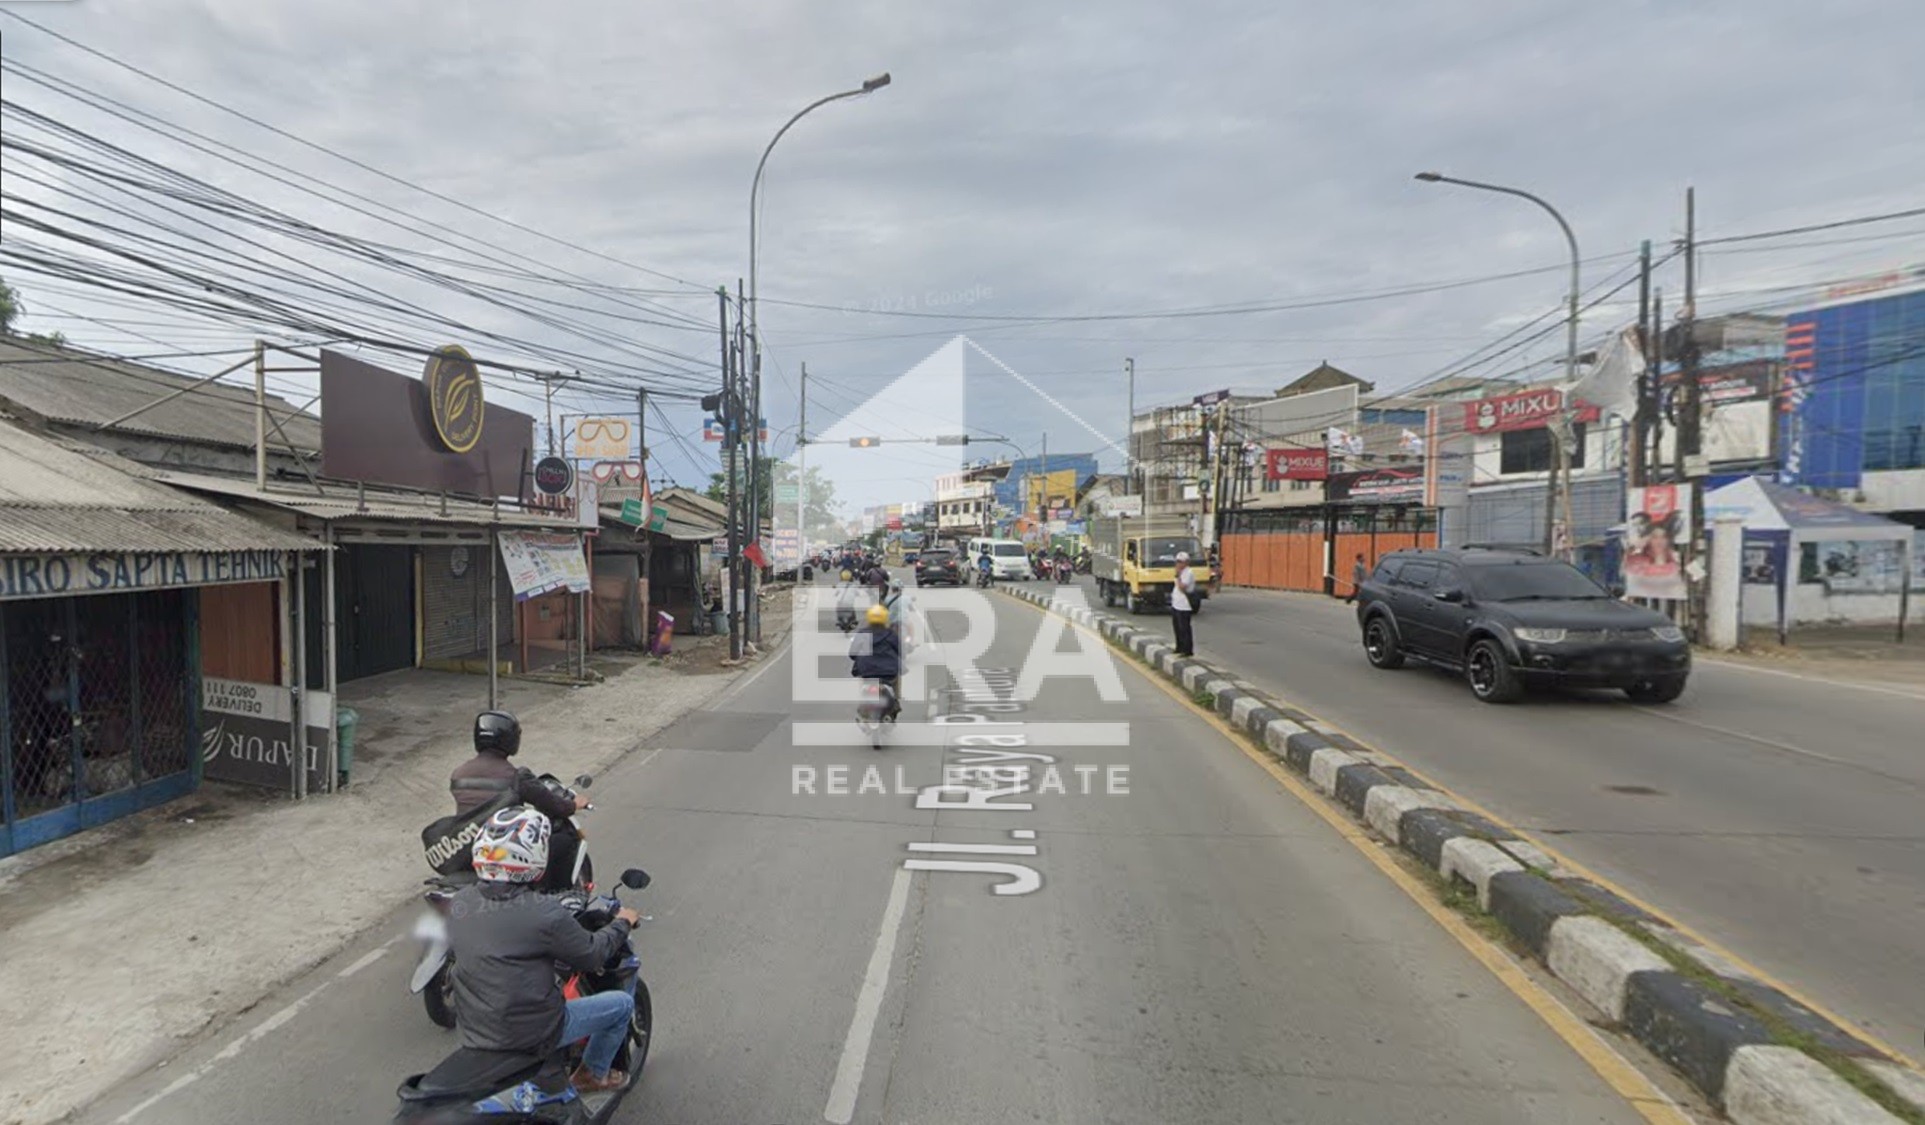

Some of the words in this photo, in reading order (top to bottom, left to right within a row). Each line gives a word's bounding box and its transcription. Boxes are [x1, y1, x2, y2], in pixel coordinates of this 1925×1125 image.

[1289, 456, 1325, 468] MIXUE
[87, 551, 188, 590] SAPTA
[201, 549, 285, 581] TEHNIK
[228, 686, 257, 699] 0807
[207, 695, 262, 714] DELIVERY
[425, 822, 481, 868] Wilson
